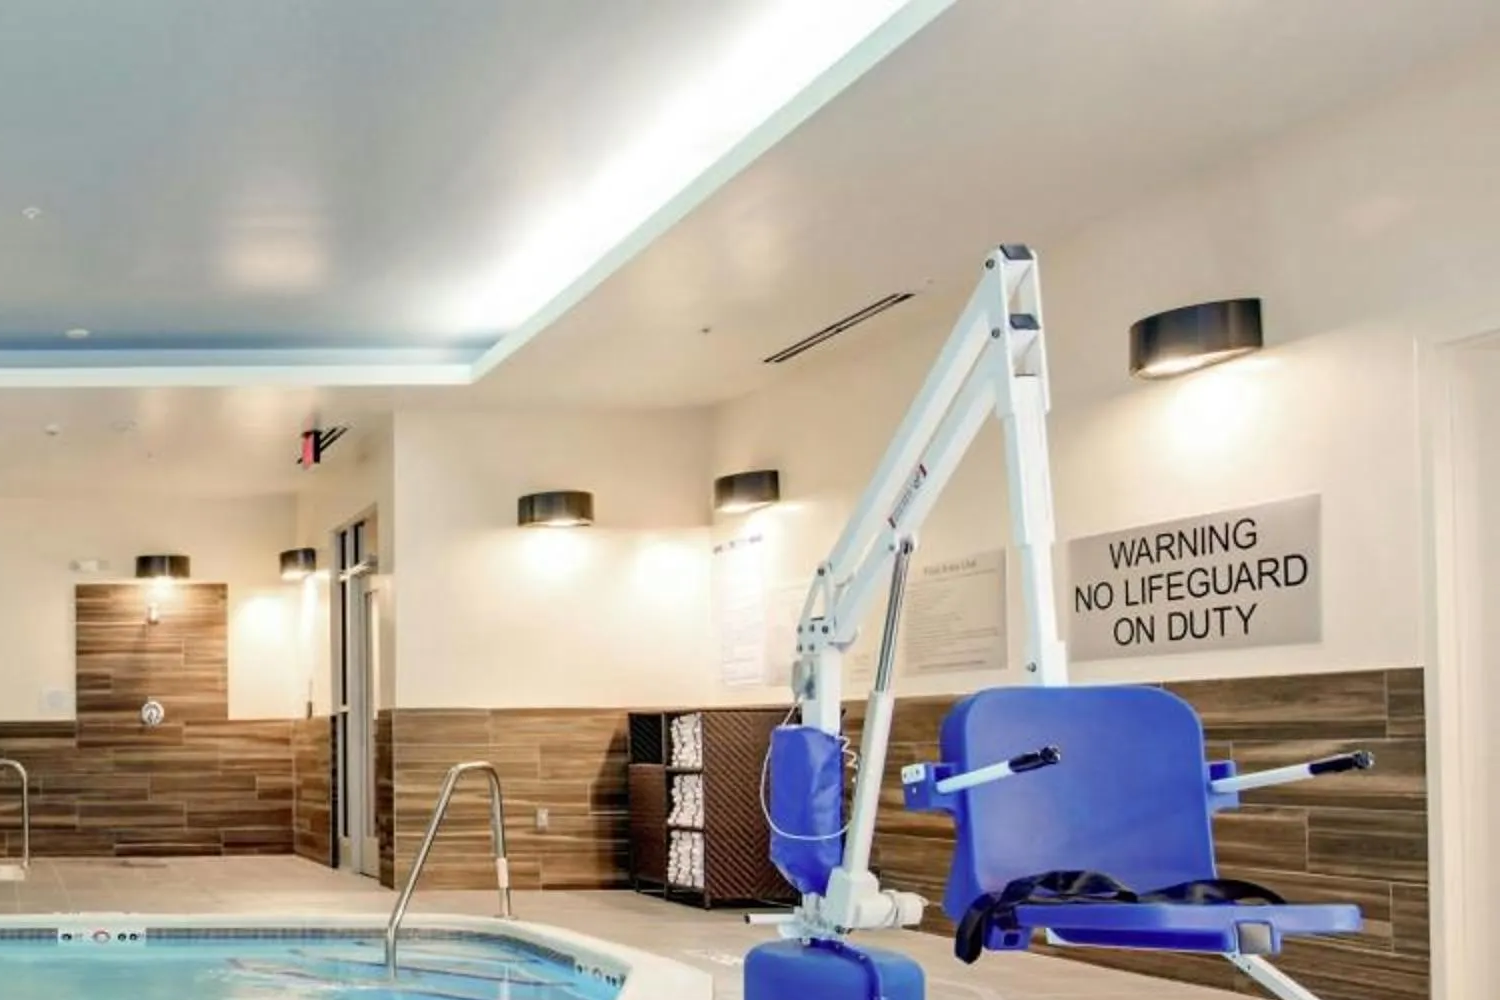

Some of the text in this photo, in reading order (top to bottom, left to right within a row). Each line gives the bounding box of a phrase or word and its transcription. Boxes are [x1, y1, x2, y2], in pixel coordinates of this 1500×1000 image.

[1109, 518, 1257, 570] WARNING
[1075, 554, 1308, 613] NO LIFEGUARD
[1113, 603, 1258, 646] ON DUTY
